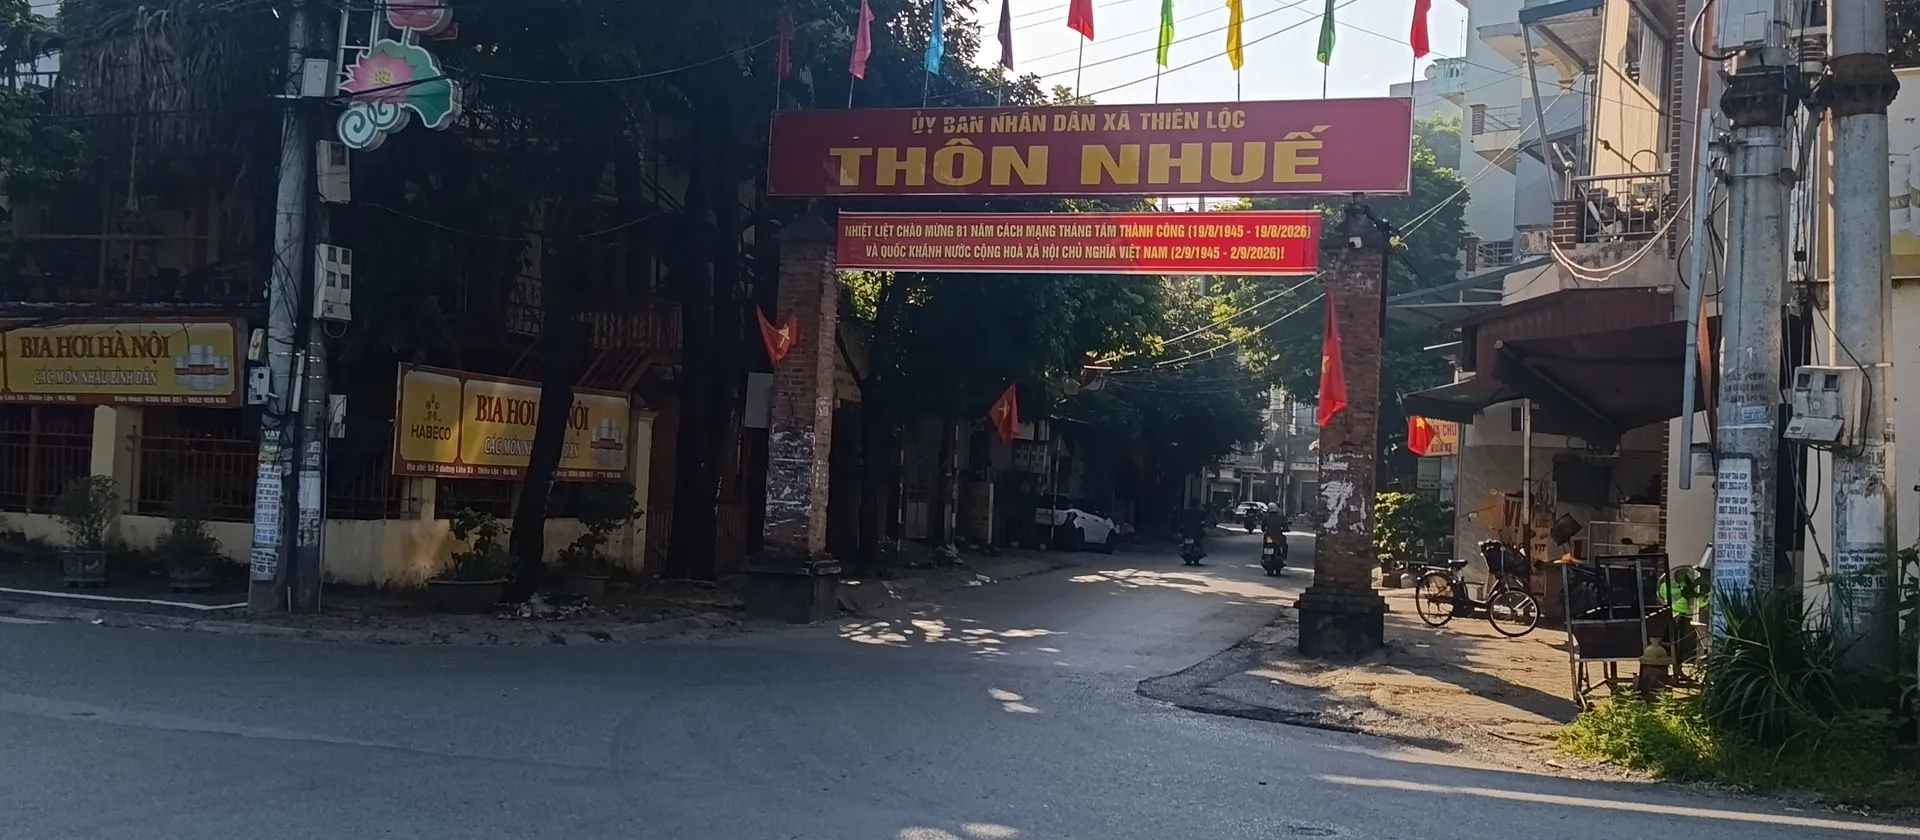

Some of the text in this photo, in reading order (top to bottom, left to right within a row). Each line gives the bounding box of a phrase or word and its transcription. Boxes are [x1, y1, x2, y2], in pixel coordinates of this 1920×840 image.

[911, 107, 1246, 135] ỦY BAN NHÂN DÂN XÃ THIÊN LỘC
[829, 124, 1333, 187] THÔN NHUẾ
[845, 223, 873, 241] NHIỆT
[875, 224, 894, 241] LIỆT
[896, 222, 922, 238] CHÀO
[924, 222, 954, 238] MỪNG
[956, 224, 968, 238] 81
[970, 223, 994, 238] NĂM
[996, 222, 1024, 238] CÁCH
[1026, 224, 1056, 241] MẠNG
[1058, 222, 1092, 238] THÁNG
[1094, 222, 1117, 238] TÁM
[1119, 222, 1154, 239] THÀNH
[1155, 222, 1185, 239] CÔNG
[1187, 224, 1244, 240] (19/8/1945
[1254, 224, 1311, 240] 19/8/2026)
[866, 243, 879, 258] VÀ
[880, 242, 907, 259] QUỐC
[908, 242, 942, 259] KHÁNH
[944, 242, 972, 258] NƯỚC
[973, 243, 1001, 261] CỘNG
[1003, 243, 1024, 259] HOÀ
[1025, 243, 1040, 259] XÃ
[1042, 243, 1060, 261] HỘI
[1061, 241, 1083, 259] CHỦ
[1084, 243, 1117, 259] NGHĨA
[1118, 243, 1142, 262] VIỆT
[1143, 245, 1168, 260] NAM
[1170, 245, 1220, 261] (2/9/1945
[1229, 245, 1285, 261] 2/9/2026)!
[20, 330, 171, 365] BIA HƠI HÀ NỘI
[33, 365, 53, 386] CÁC
[55, 366, 78, 386] MÓN
[135, 366, 158, 386] DÂN
[474, 395, 505, 424] BIA
[505, 398, 537, 426] HƠI
[410, 424, 452, 441] HABECO
[484, 433, 502, 455] CÁC
